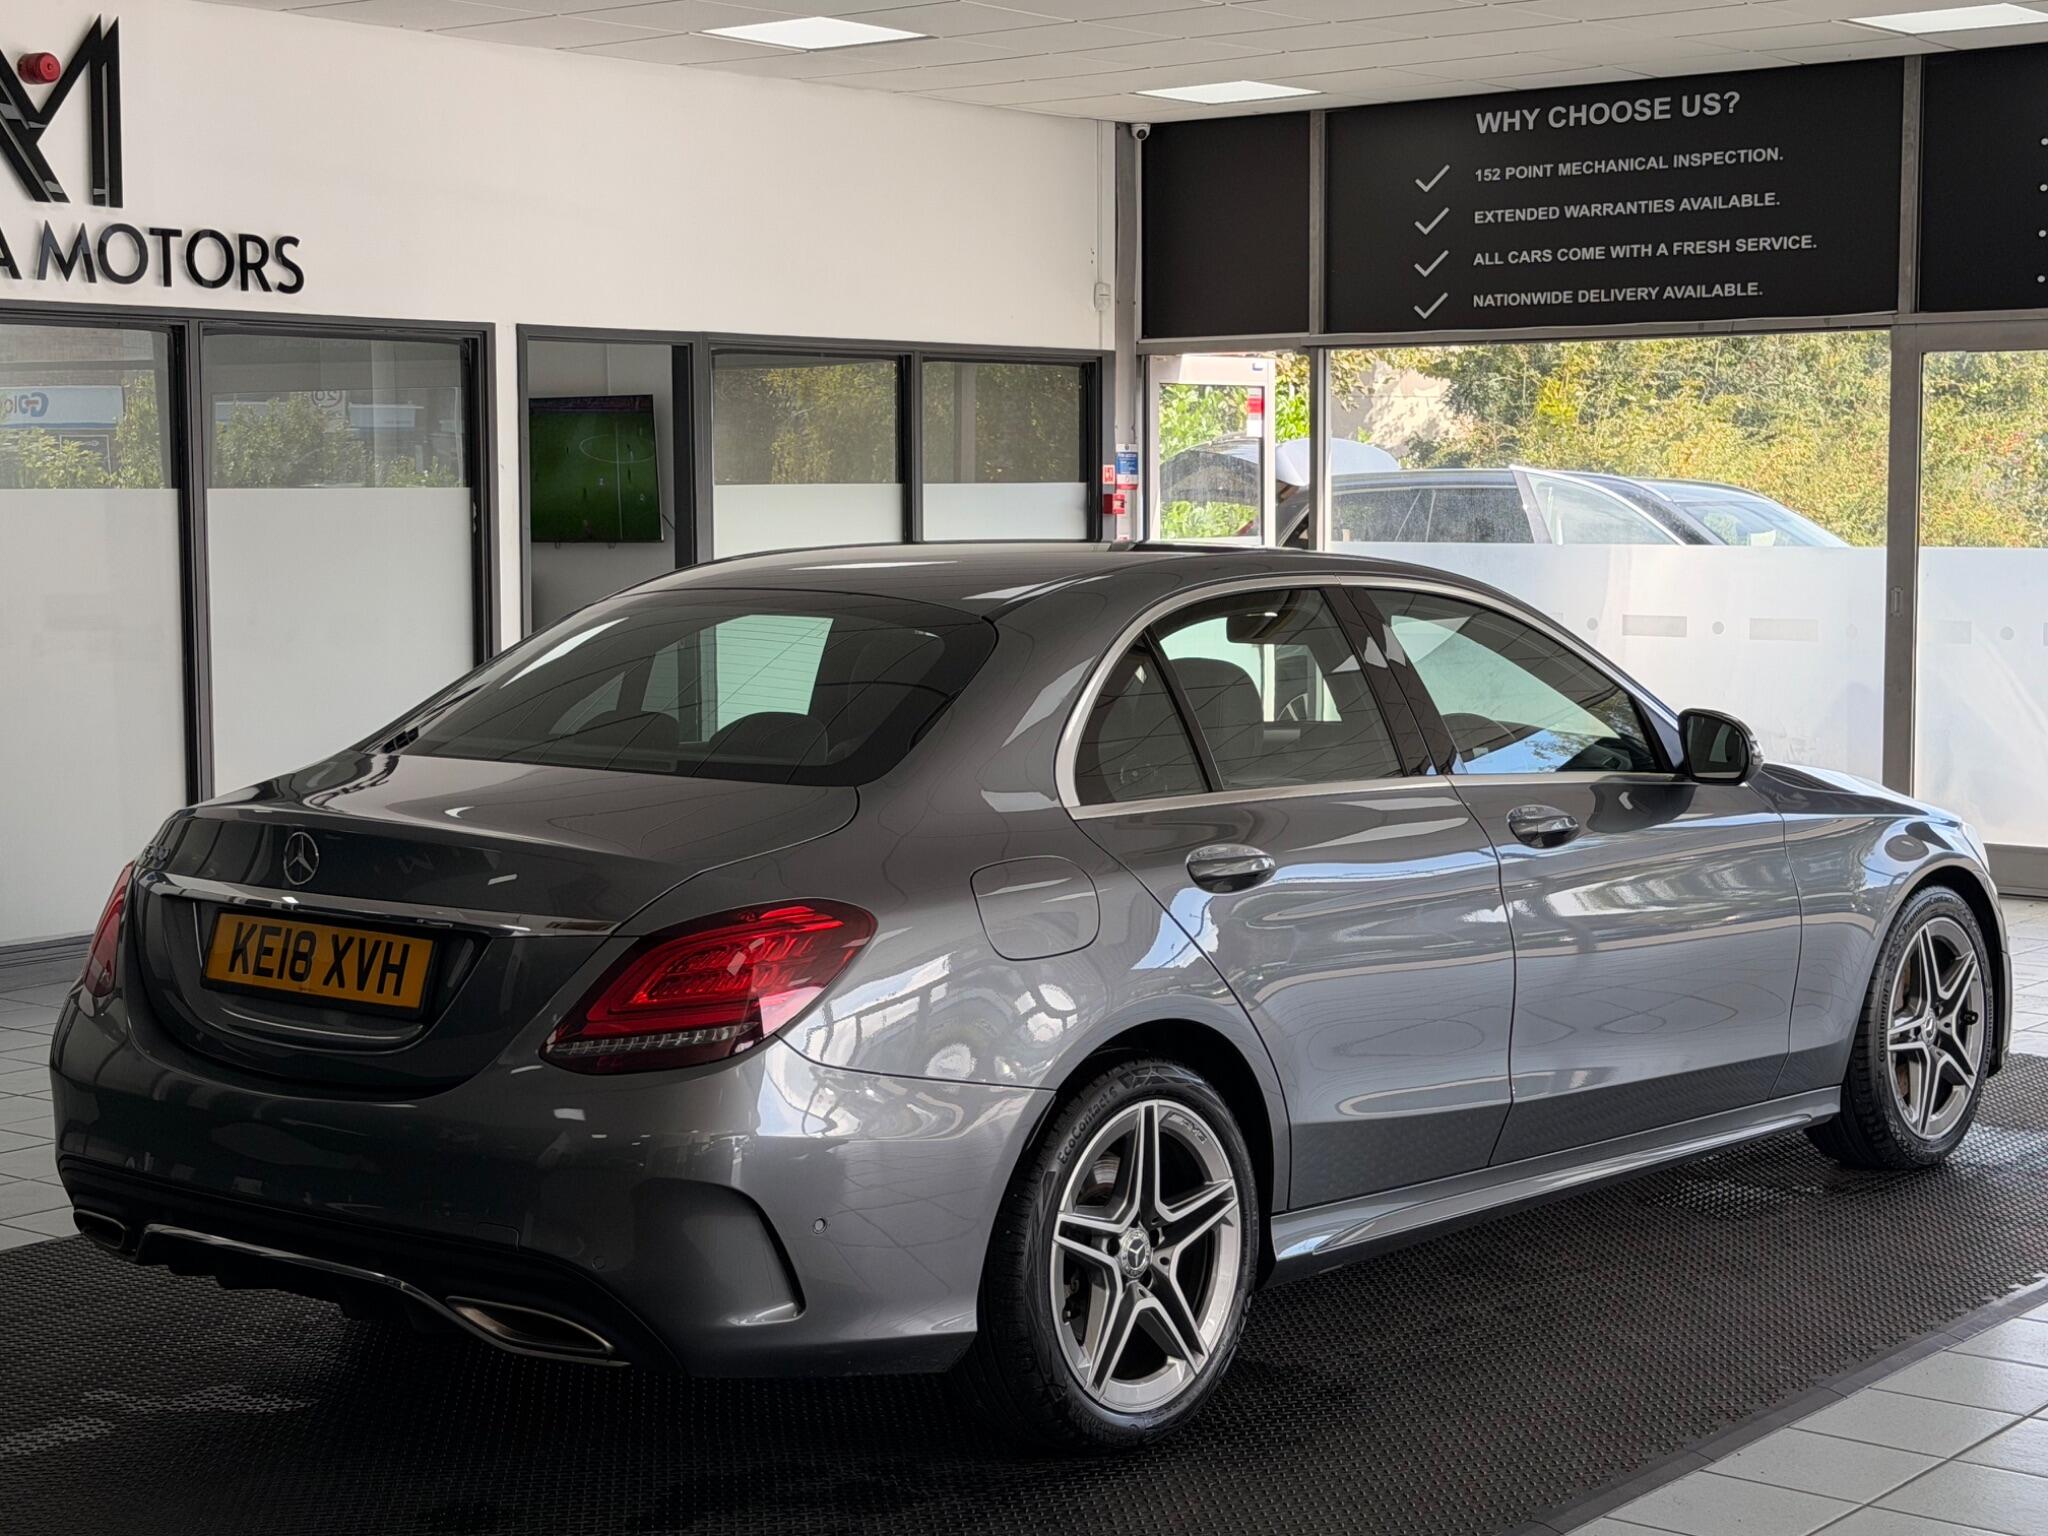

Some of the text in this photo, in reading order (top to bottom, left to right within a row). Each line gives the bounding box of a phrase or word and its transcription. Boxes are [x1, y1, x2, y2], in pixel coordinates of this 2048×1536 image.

[1475, 90, 1741, 135] WHY CHOOSE US?
[1475, 146, 1784, 182] 152 POINT MECHANICAL INSPECTION.
[1474, 191, 1781, 225] EXTENDED WARRANTIES AVAILABLE.
[36, 219, 305, 295] MOTORS
[1473, 234, 1818, 266] ALL CARS COME WITH A FRESH SERVICE.
[1473, 281, 1764, 308] NATIONWIDE DELIVERY AVAILABLE.
[227, 921, 411, 997] KE18 XVH
